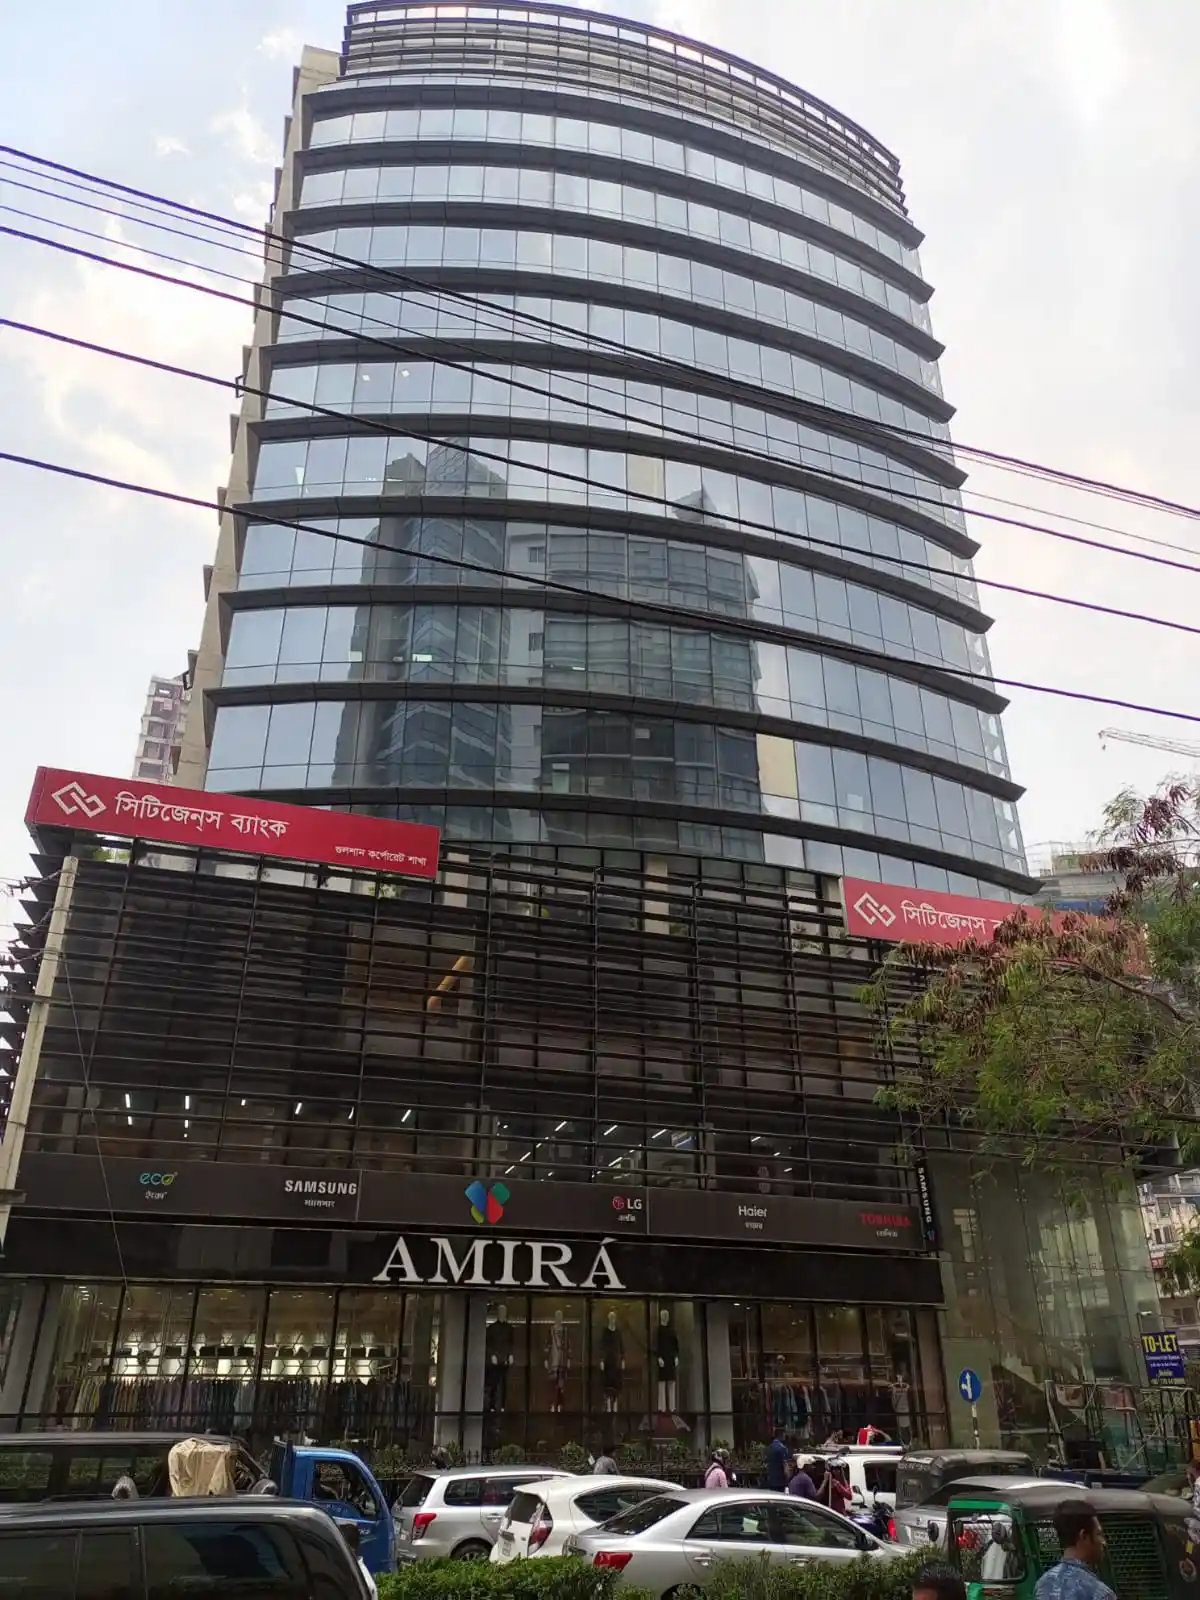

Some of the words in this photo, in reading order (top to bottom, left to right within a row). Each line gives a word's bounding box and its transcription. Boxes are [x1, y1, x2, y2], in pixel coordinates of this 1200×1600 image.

[230, 813, 290, 839] ব্যাংক
[284, 1180, 358, 1195] SAMSUNG
[918, 1167, 932, 1223] SAMSUNG
[627, 1198, 642, 1210] LG
[738, 1205, 767, 1217] Haier
[372, 1236, 627, 1289] AMIRÁ
[1142, 1334, 1178, 1353] TO-LET
